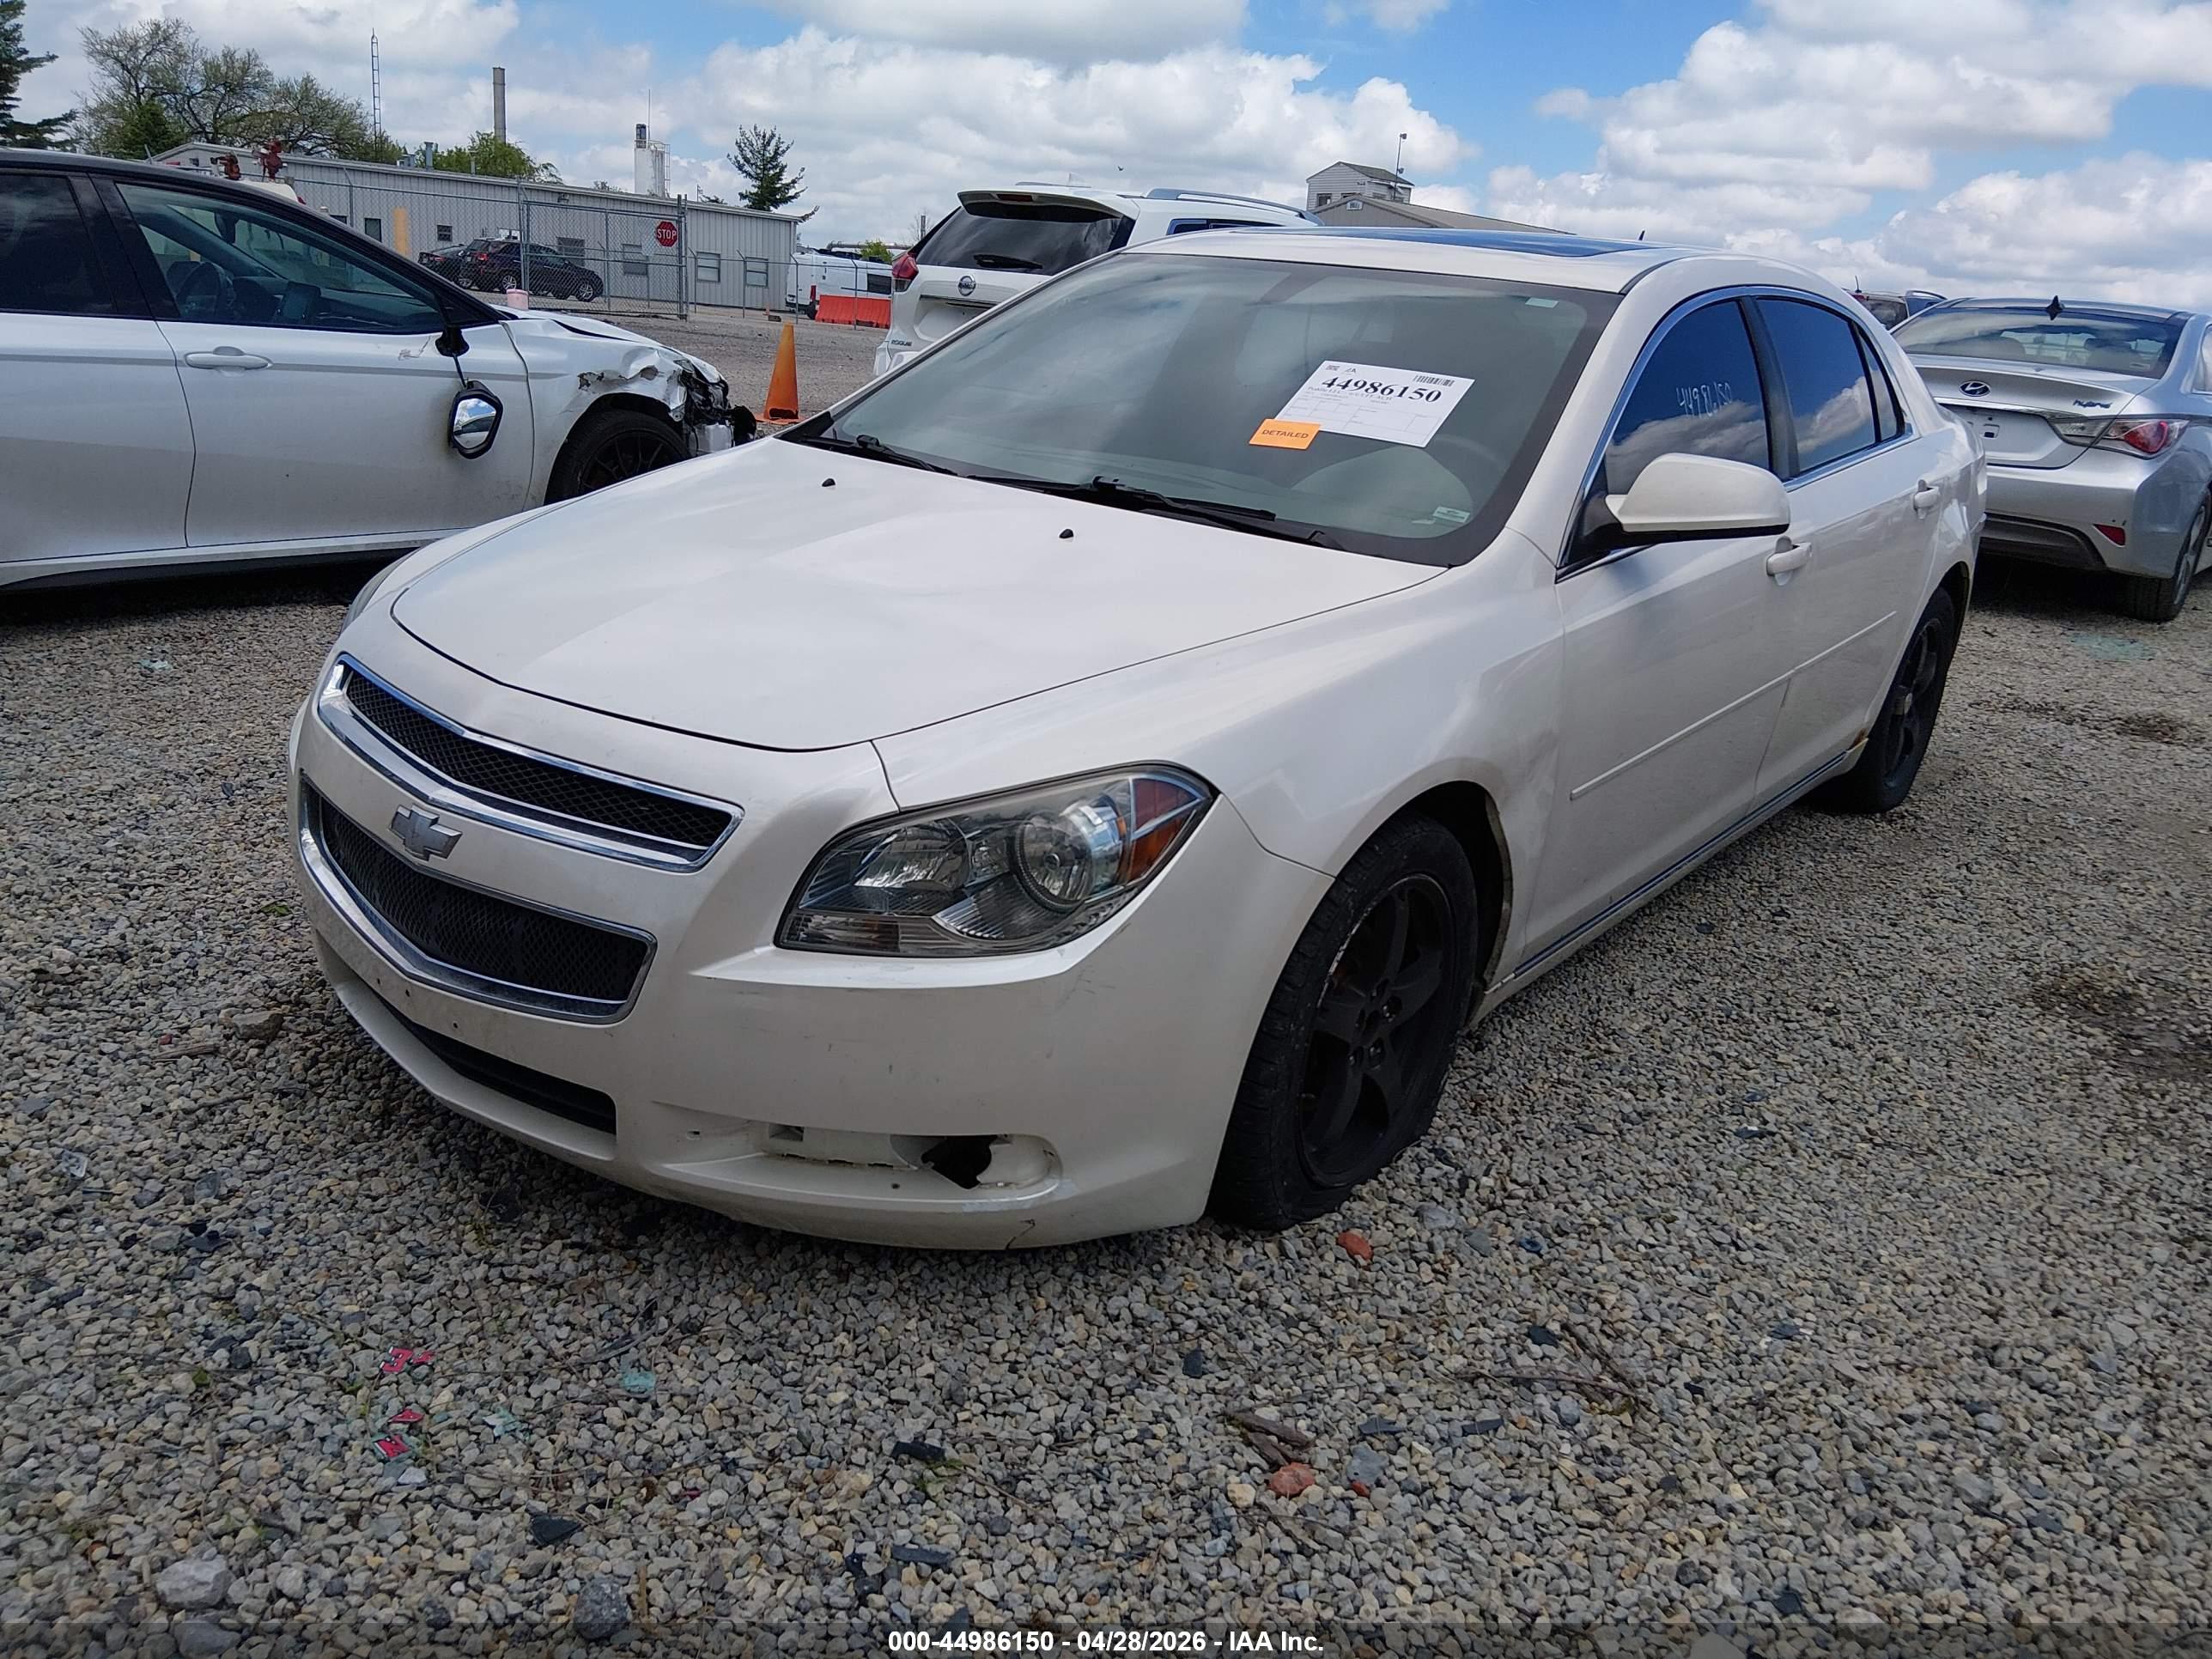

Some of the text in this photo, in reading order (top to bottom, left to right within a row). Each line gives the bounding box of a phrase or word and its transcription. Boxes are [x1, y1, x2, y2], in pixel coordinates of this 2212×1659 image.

[657, 228, 677, 240] STOP
[1322, 376, 1442, 403] 44986150
[1261, 429, 1310, 439] DETAILED
